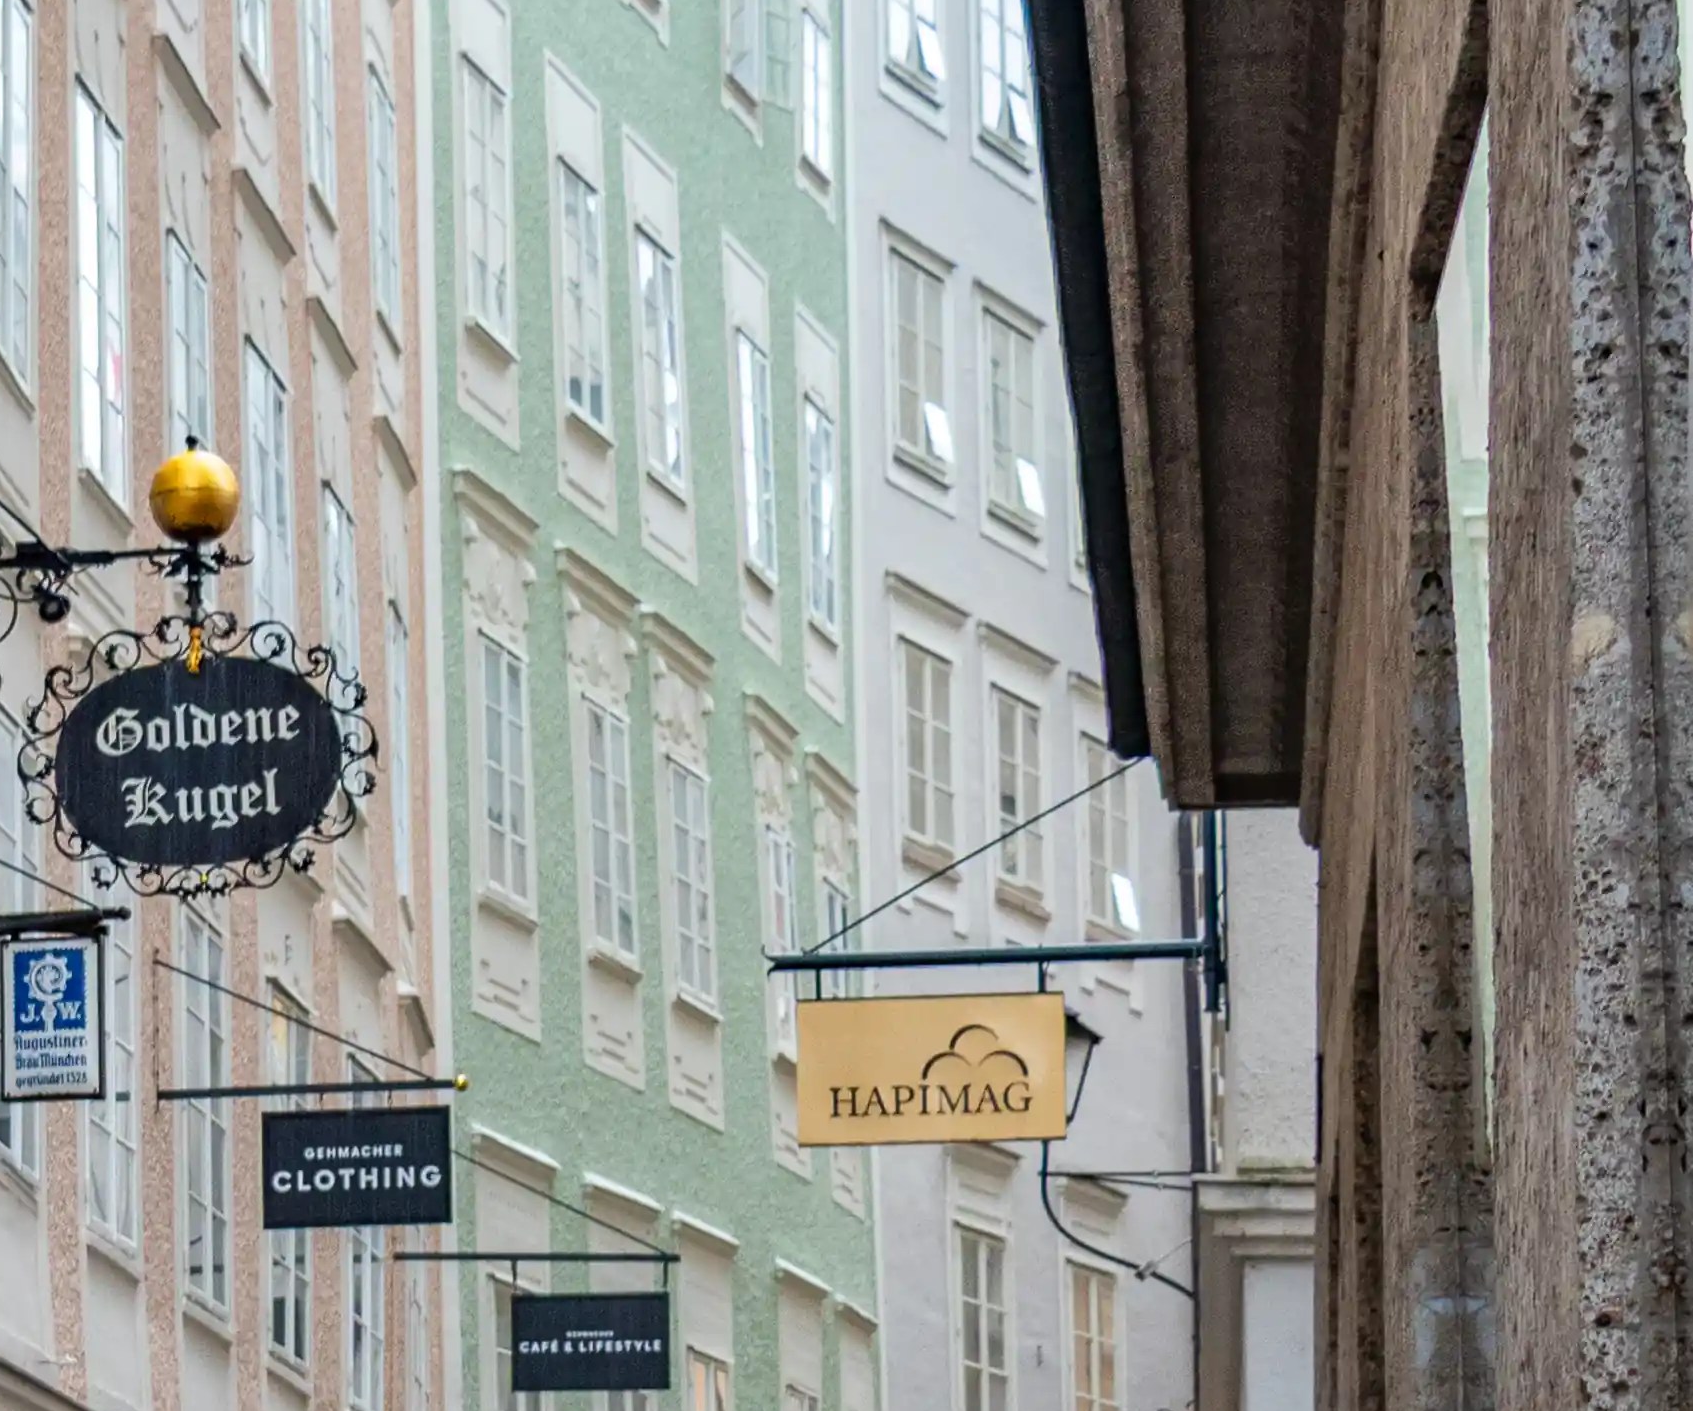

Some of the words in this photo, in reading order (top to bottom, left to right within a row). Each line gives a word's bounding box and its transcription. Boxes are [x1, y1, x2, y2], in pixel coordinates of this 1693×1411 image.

[96, 702, 301, 757] Goldene
[121, 768, 282, 831] Kugel
[829, 1081, 1034, 1119] HAPIMAG
[303, 1144, 404, 1161] GEHMACHER
[272, 1164, 442, 1192] CLOTHING
[518, 1338, 558, 1354] CAFÉ
[563, 1341, 573, 1354] &
[578, 1338, 662, 1354] LIFESTYLE
